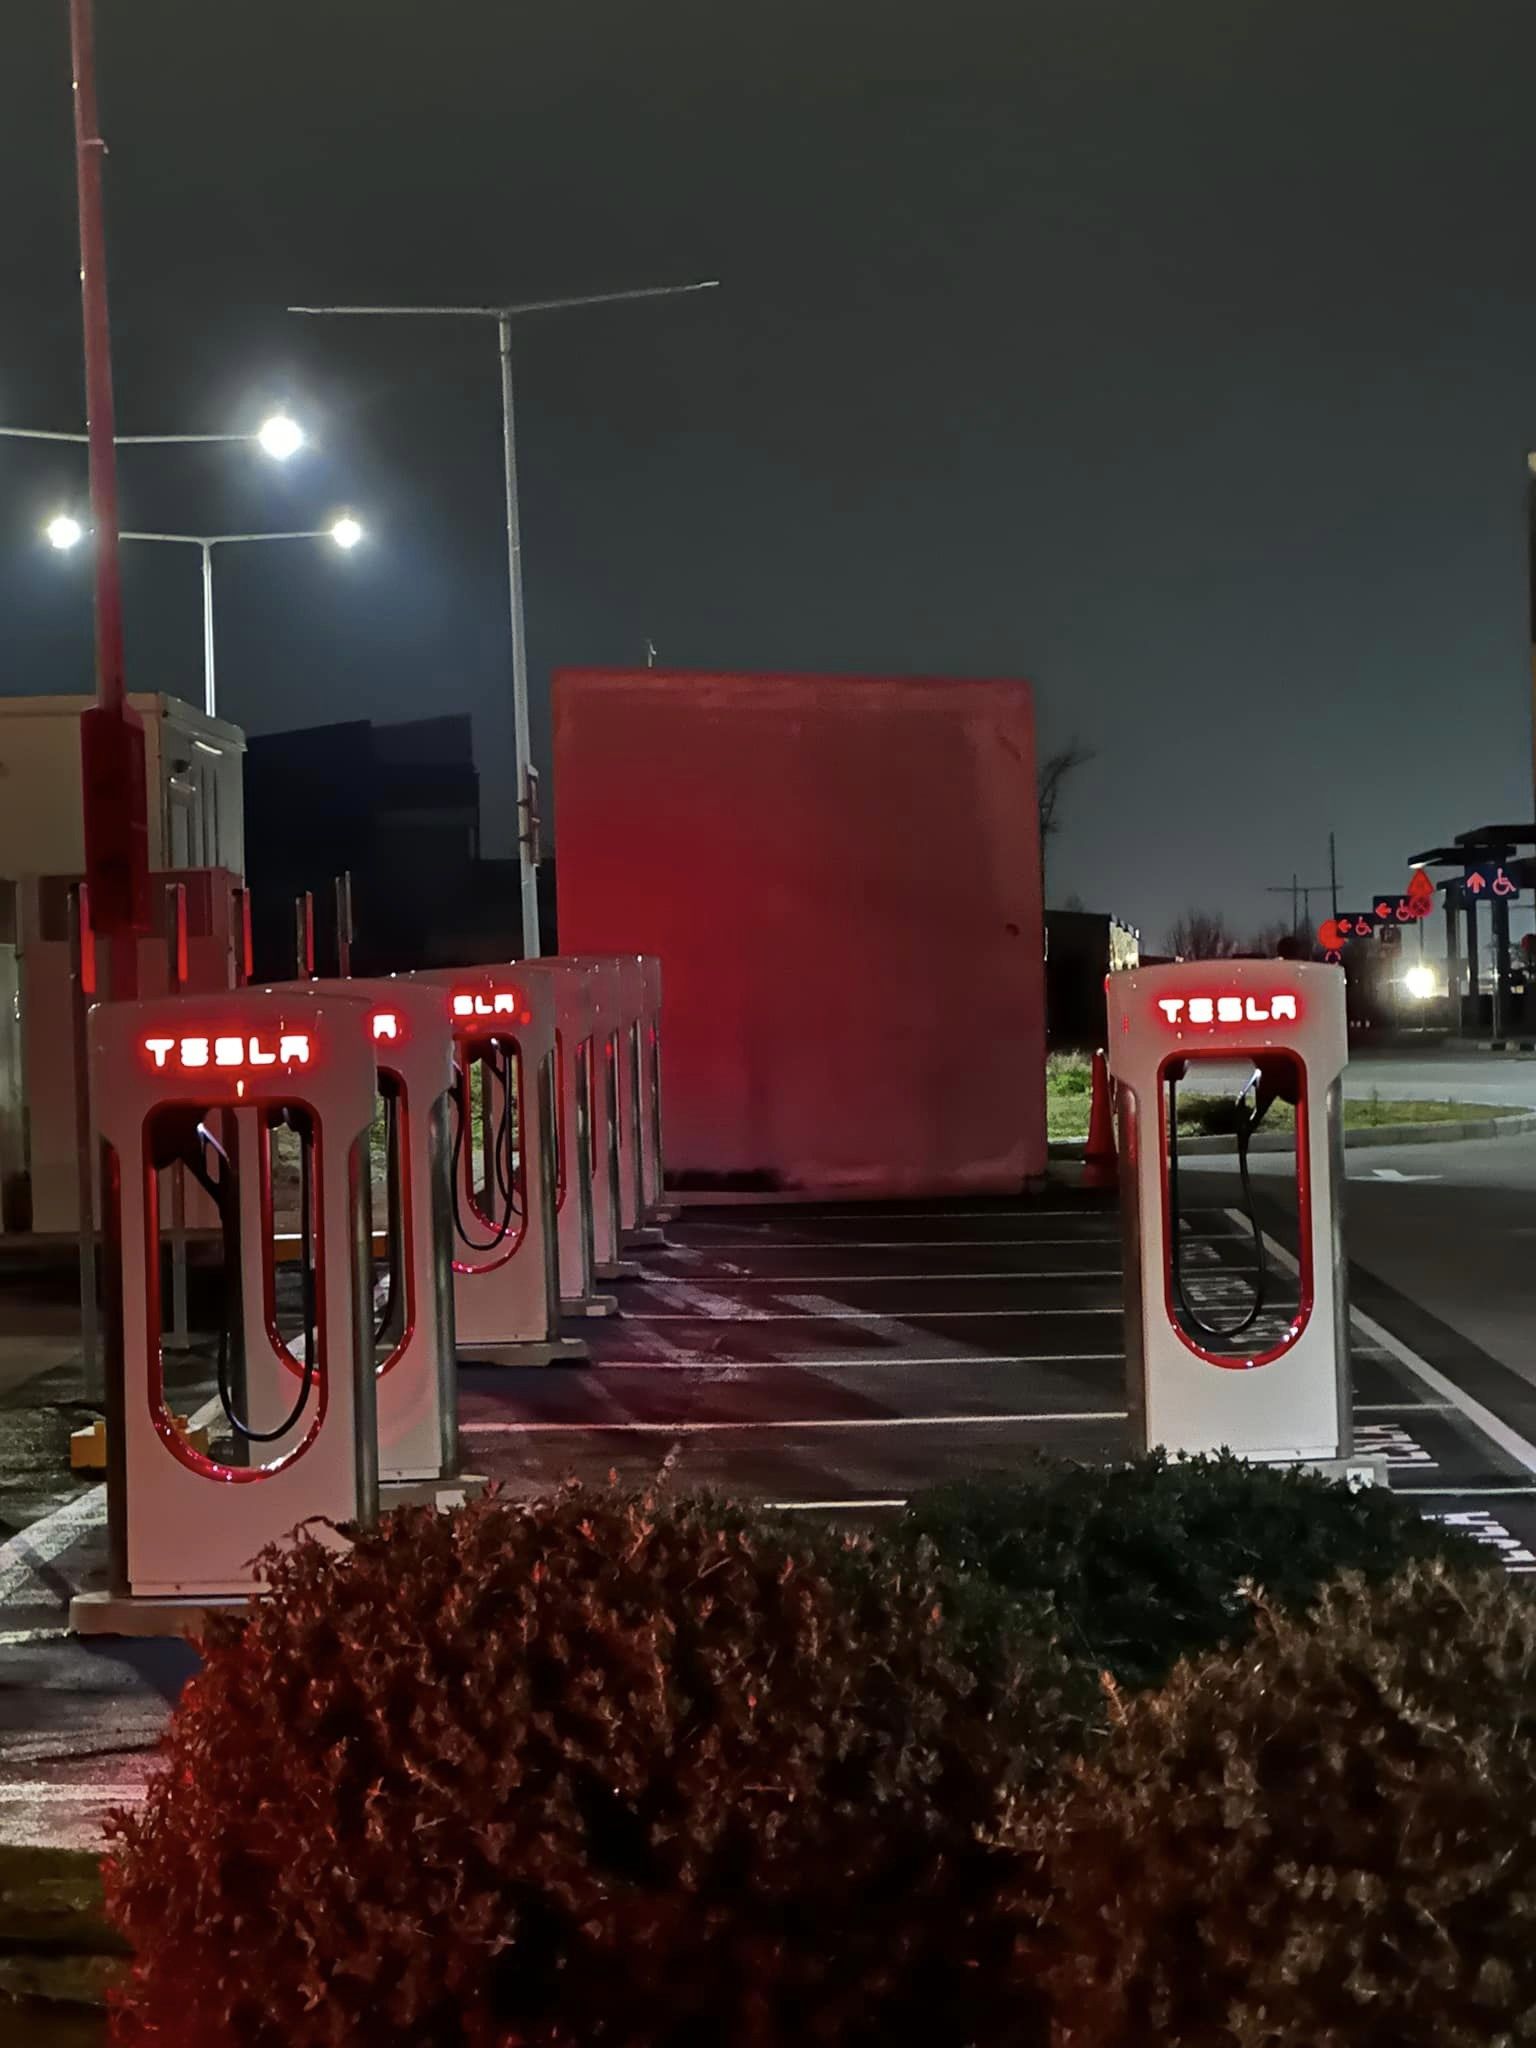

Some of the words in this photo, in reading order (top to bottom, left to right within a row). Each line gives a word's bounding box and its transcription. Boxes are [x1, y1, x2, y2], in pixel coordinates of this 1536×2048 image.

[453, 994, 514, 1015] SLA
[1157, 995, 1297, 1024] TESLA
[144, 1034, 310, 1068] TESLA
